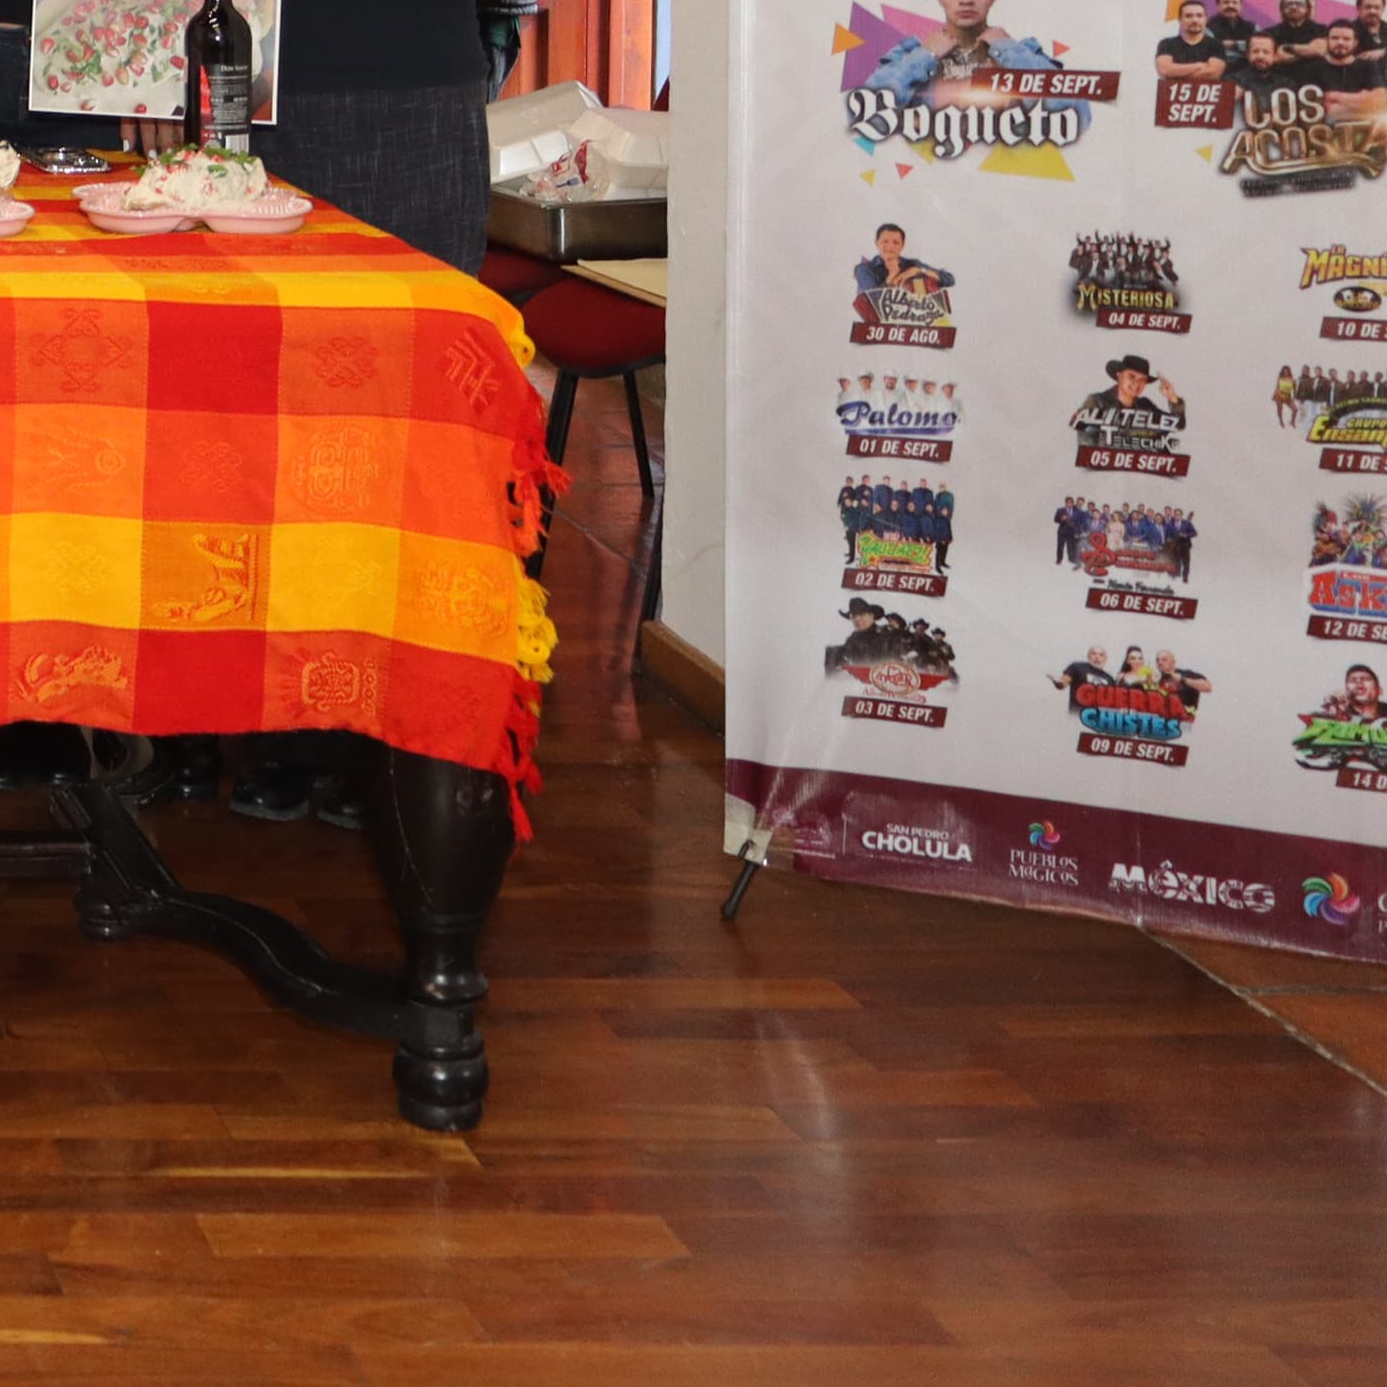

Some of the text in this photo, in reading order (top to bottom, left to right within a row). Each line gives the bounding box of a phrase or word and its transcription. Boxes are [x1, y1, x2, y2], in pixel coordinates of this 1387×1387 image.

[990, 73, 1102, 94] 13 DE SEPT.
[1169, 84, 1222, 102] 15 DE
[1168, 104, 1217, 123] SEPT.
[1245, 85, 1324, 129] LOS
[1108, 312, 1180, 330] 04 DE SEPT.
[1337, 322, 1381, 338] 10 DE
[867, 327, 940, 344] 30 DE AGO.
[1120, 409, 1179, 432] TELEZ
[859, 439, 939, 458] 01 DE SEPT.
[1090, 451, 1176, 472] 05 DE SEPT.
[1337, 454, 1380, 470] 11 DE
[855, 572, 934, 592] 02 DE SEPT.
[1100, 593, 1184, 615] 06 DE SEPT.
[1324, 621, 1367, 637] 12 DE
[855, 701, 934, 723] 03 DE SEPT.
[1076, 683, 1195, 723] GUERRA
[1091, 739, 1174, 762] 09 DE SEPT.
[887, 823, 949, 840] SAN PEDRO
[862, 831, 972, 862] CHOLULA
